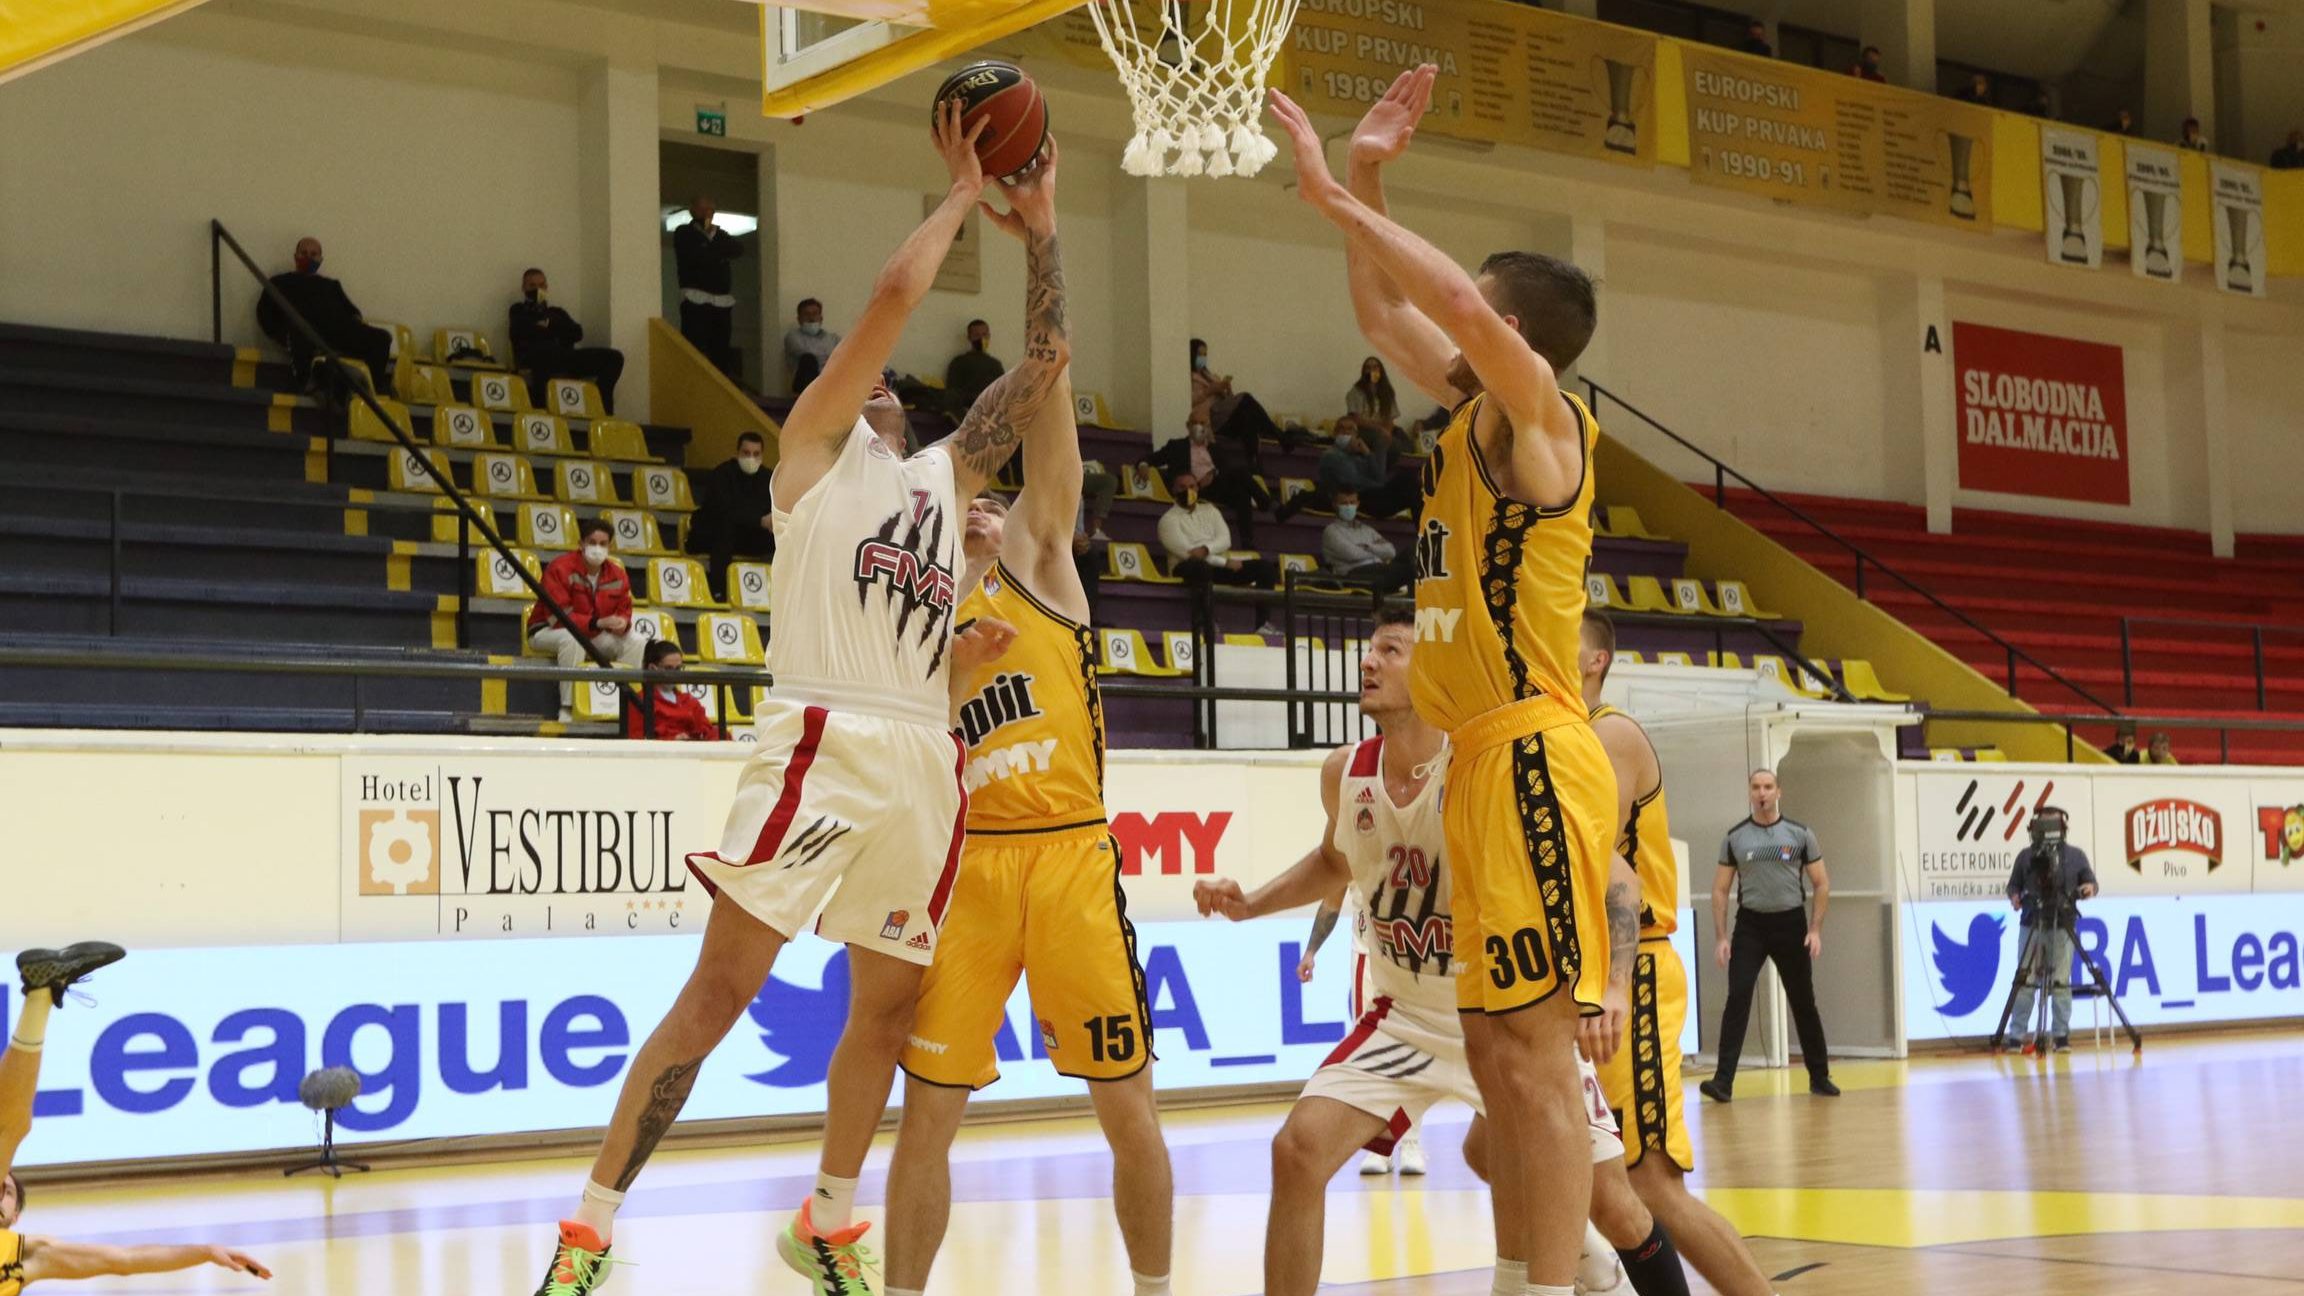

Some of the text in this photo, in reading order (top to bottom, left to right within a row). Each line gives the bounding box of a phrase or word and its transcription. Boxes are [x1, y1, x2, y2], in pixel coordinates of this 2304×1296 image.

[1294, 24, 1459, 76] KUP PRVAKA
[1694, 70, 1799, 111] EUROPSKI
[1696, 107, 1827, 152] KUP PRVAKA
[1924, 324, 1942, 354] A
[1964, 368, 2106, 421] SLOBODNA
[1965, 407, 2120, 460] DALMACIJA
[953, 673, 1042, 747] plit
[361, 775, 432, 801] Hotel
[447, 776, 687, 895] VESTIBUL
[1108, 811, 1234, 876] MY
[2132, 802, 2215, 852] Ožujsko
[1388, 845, 1432, 888] 20
[2163, 861, 2187, 877] Pivo
[455, 906, 681, 933] Palace
[1486, 927, 1550, 990] 30
[1083, 1014, 1135, 1062] 15
